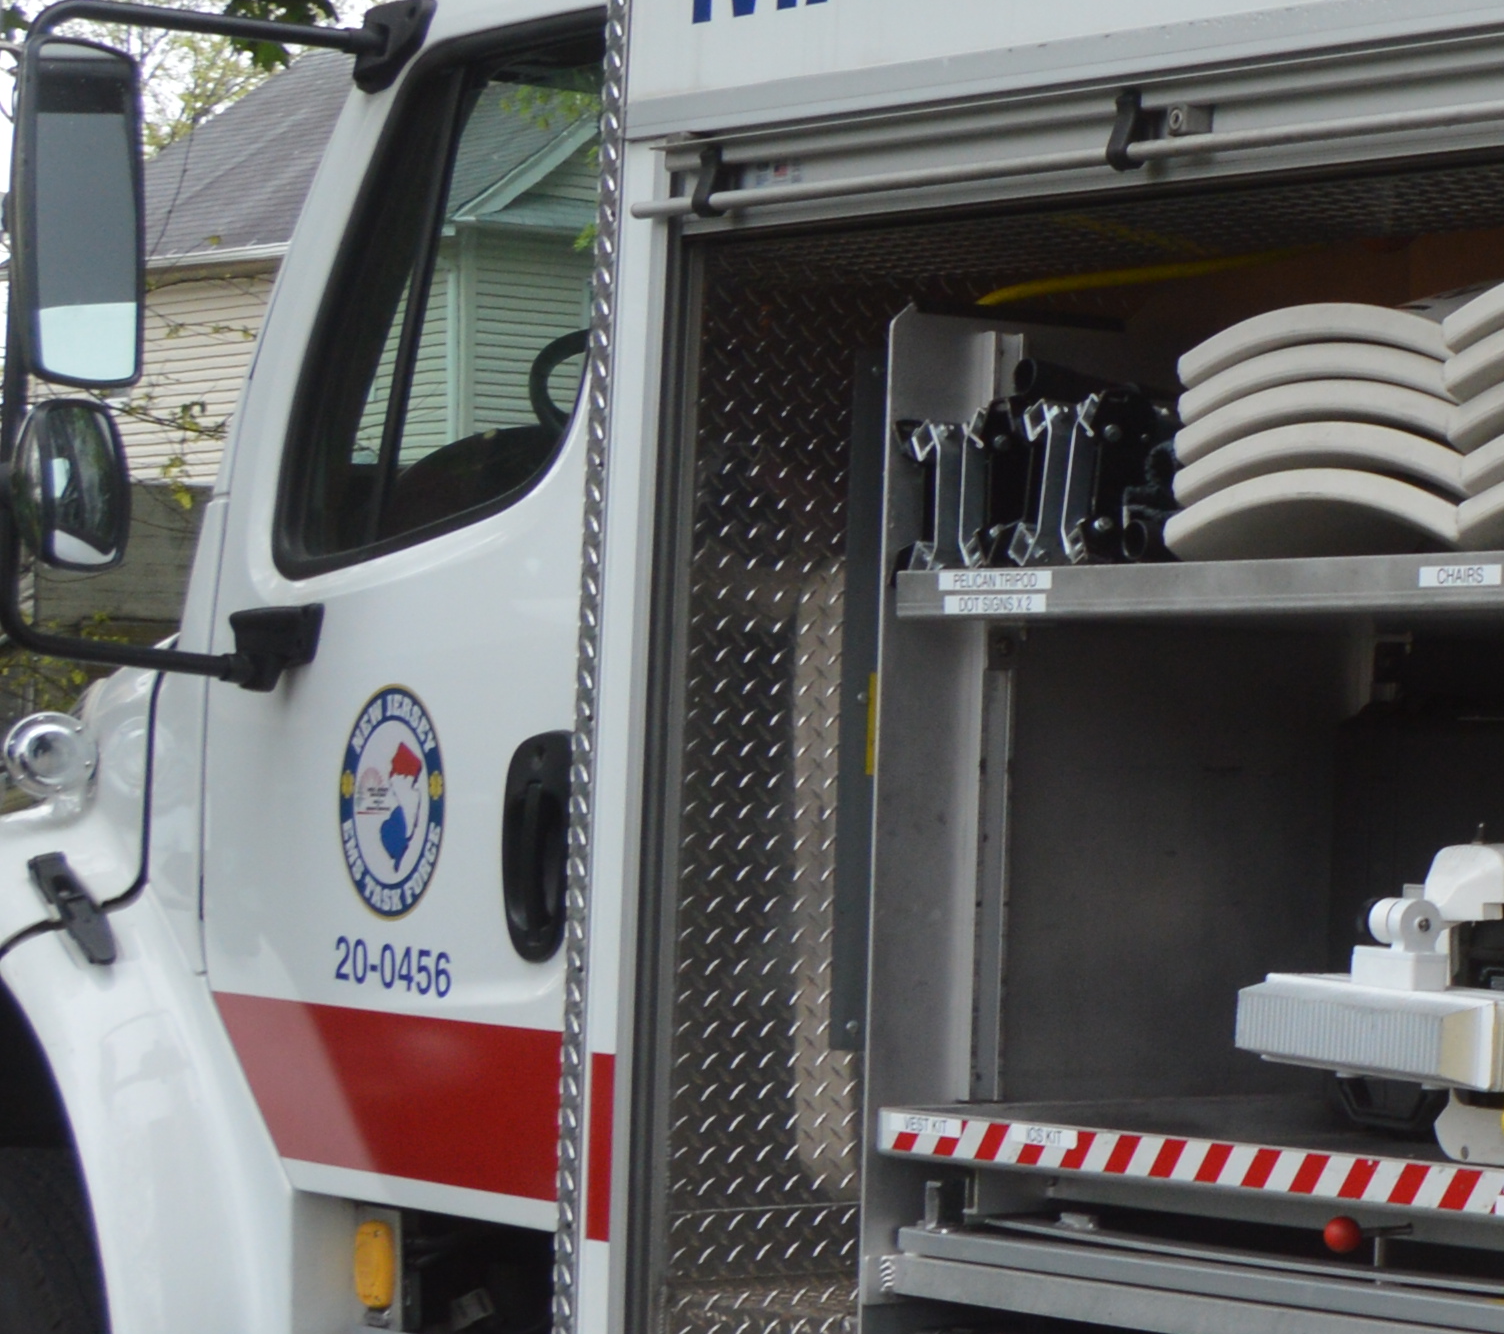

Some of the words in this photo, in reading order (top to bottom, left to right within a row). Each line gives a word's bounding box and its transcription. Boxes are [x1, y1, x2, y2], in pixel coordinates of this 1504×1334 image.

[953, 573, 996, 588] PELICAN
[999, 572, 1038, 588] TRIPOD
[1437, 567, 1484, 584] CHAIRS
[958, 596, 980, 612] DOT
[982, 596, 1014, 612] SIGNS
[1016, 597, 1024, 611] X
[1025, 596, 1032, 611] 2
[351, 698, 382, 755] NEW
[386, 694, 437, 754] JERSEY
[343, 818, 365, 881] EMS
[364, 873, 402, 911] TASK
[403, 821, 441, 905] FORCE
[335, 936, 451, 998] 20-0456
[904, 1117, 928, 1133] VEST
[931, 1119, 947, 1135] KIT
[1026, 1127, 1044, 1143] ICS
[1045, 1128, 1062, 1145] KIT
